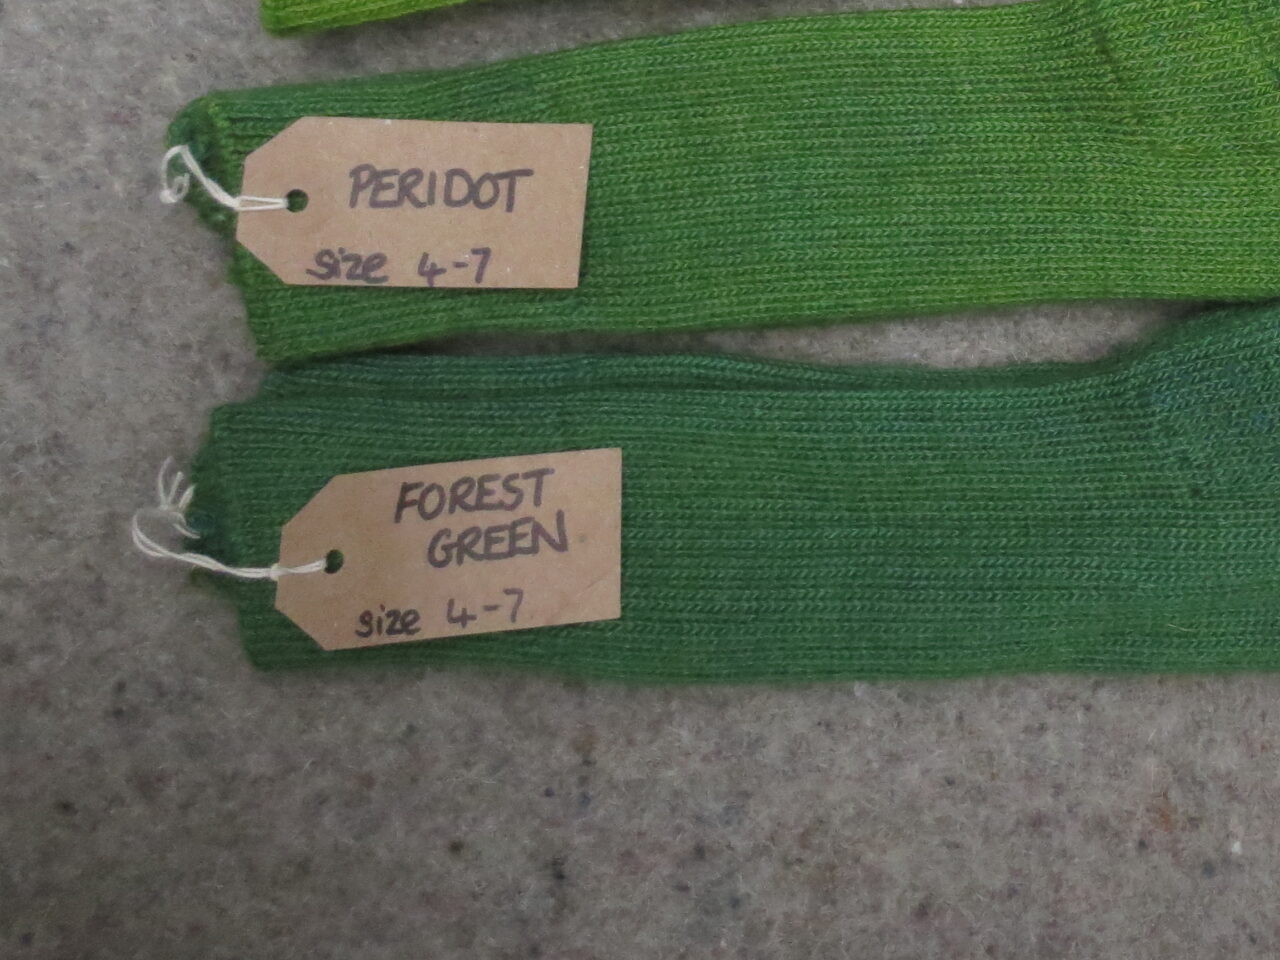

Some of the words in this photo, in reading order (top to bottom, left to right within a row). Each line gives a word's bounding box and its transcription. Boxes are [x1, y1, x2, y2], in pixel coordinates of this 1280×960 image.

[349, 163, 534, 212] PERIDOT
[305, 247, 390, 284] size
[394, 468, 555, 524] FOREST
[427, 509, 568, 568] GREEN
[354, 604, 422, 638] size
